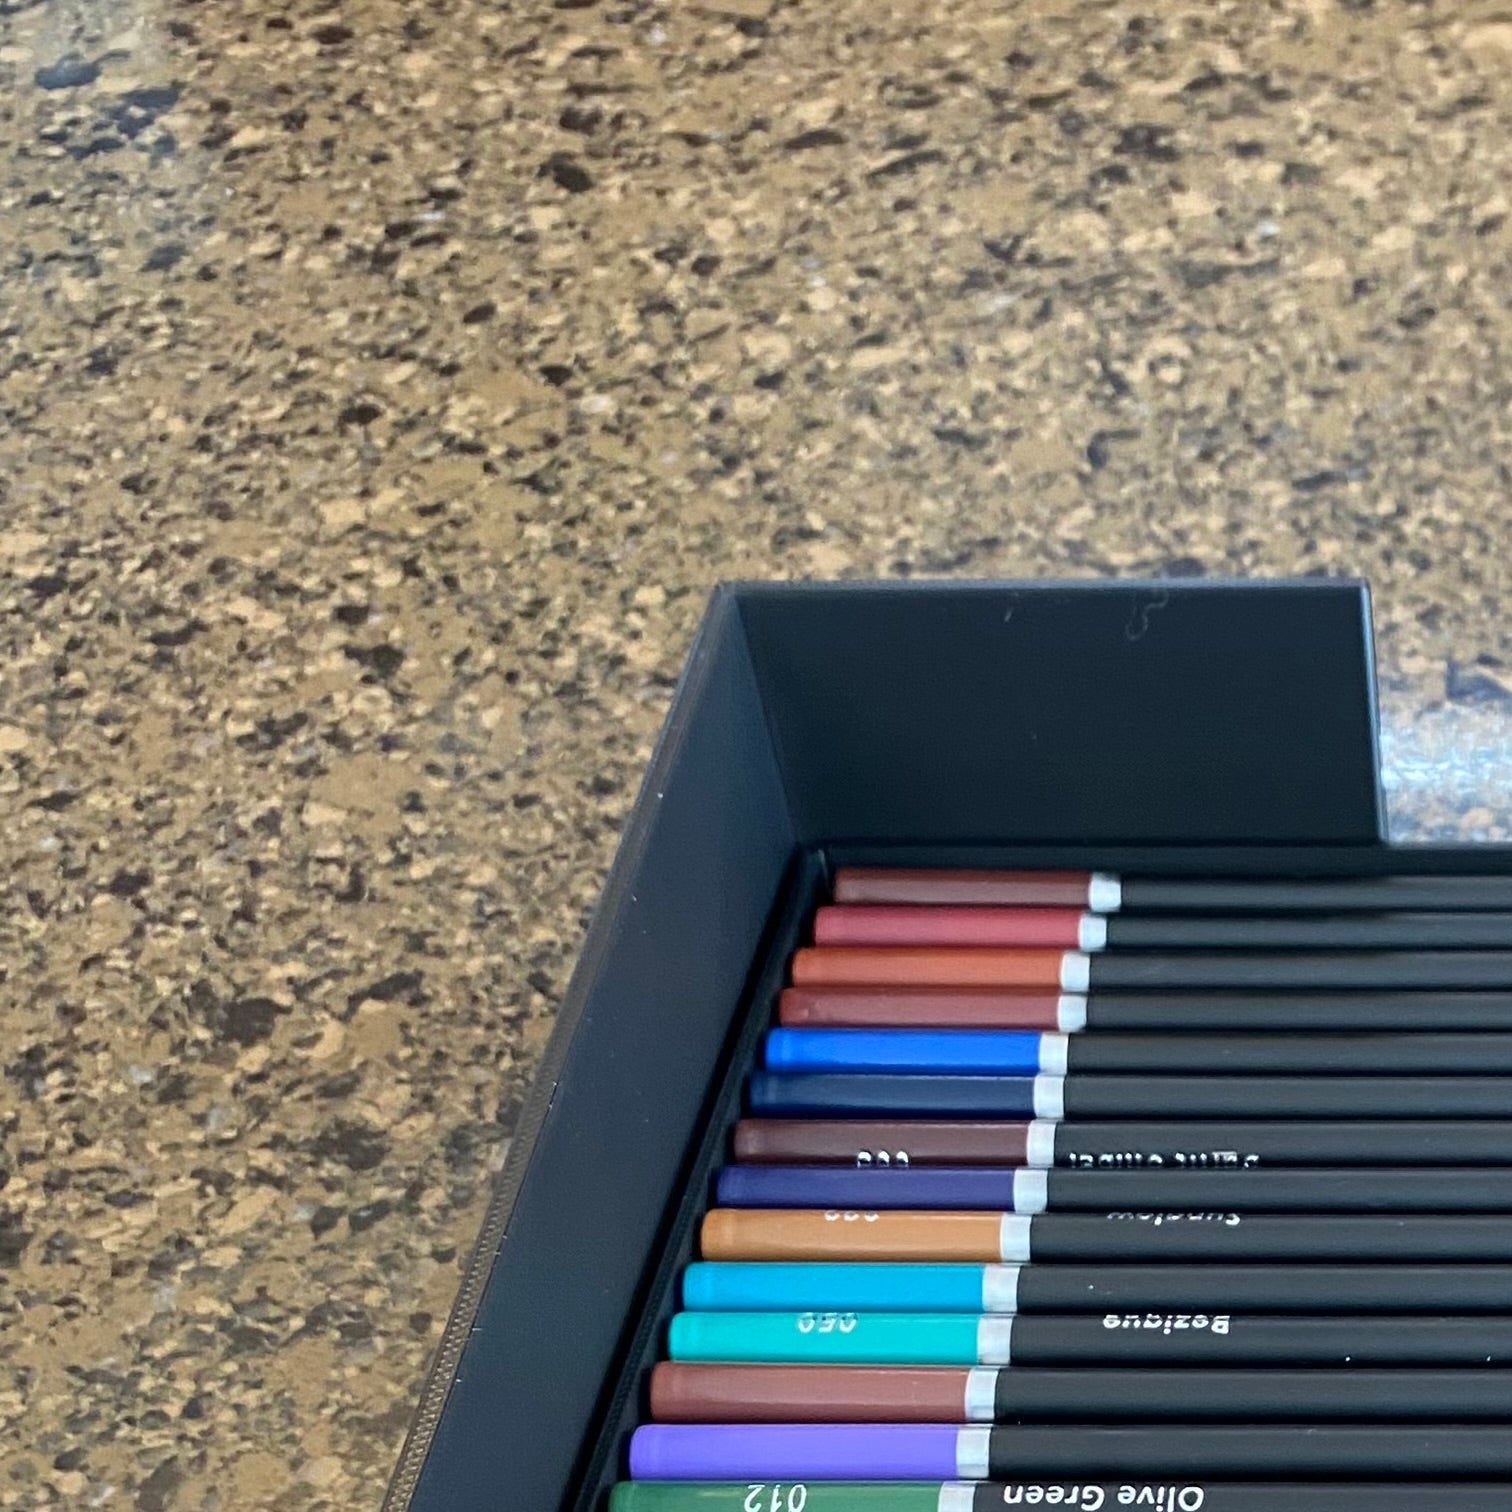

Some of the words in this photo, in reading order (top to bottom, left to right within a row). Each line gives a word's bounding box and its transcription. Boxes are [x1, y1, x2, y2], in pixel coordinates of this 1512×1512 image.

[1103, 1313, 1230, 1334] Bezique
[1003, 1485, 1105, 1511] Green
[1117, 1485, 1204, 1512] Olive
